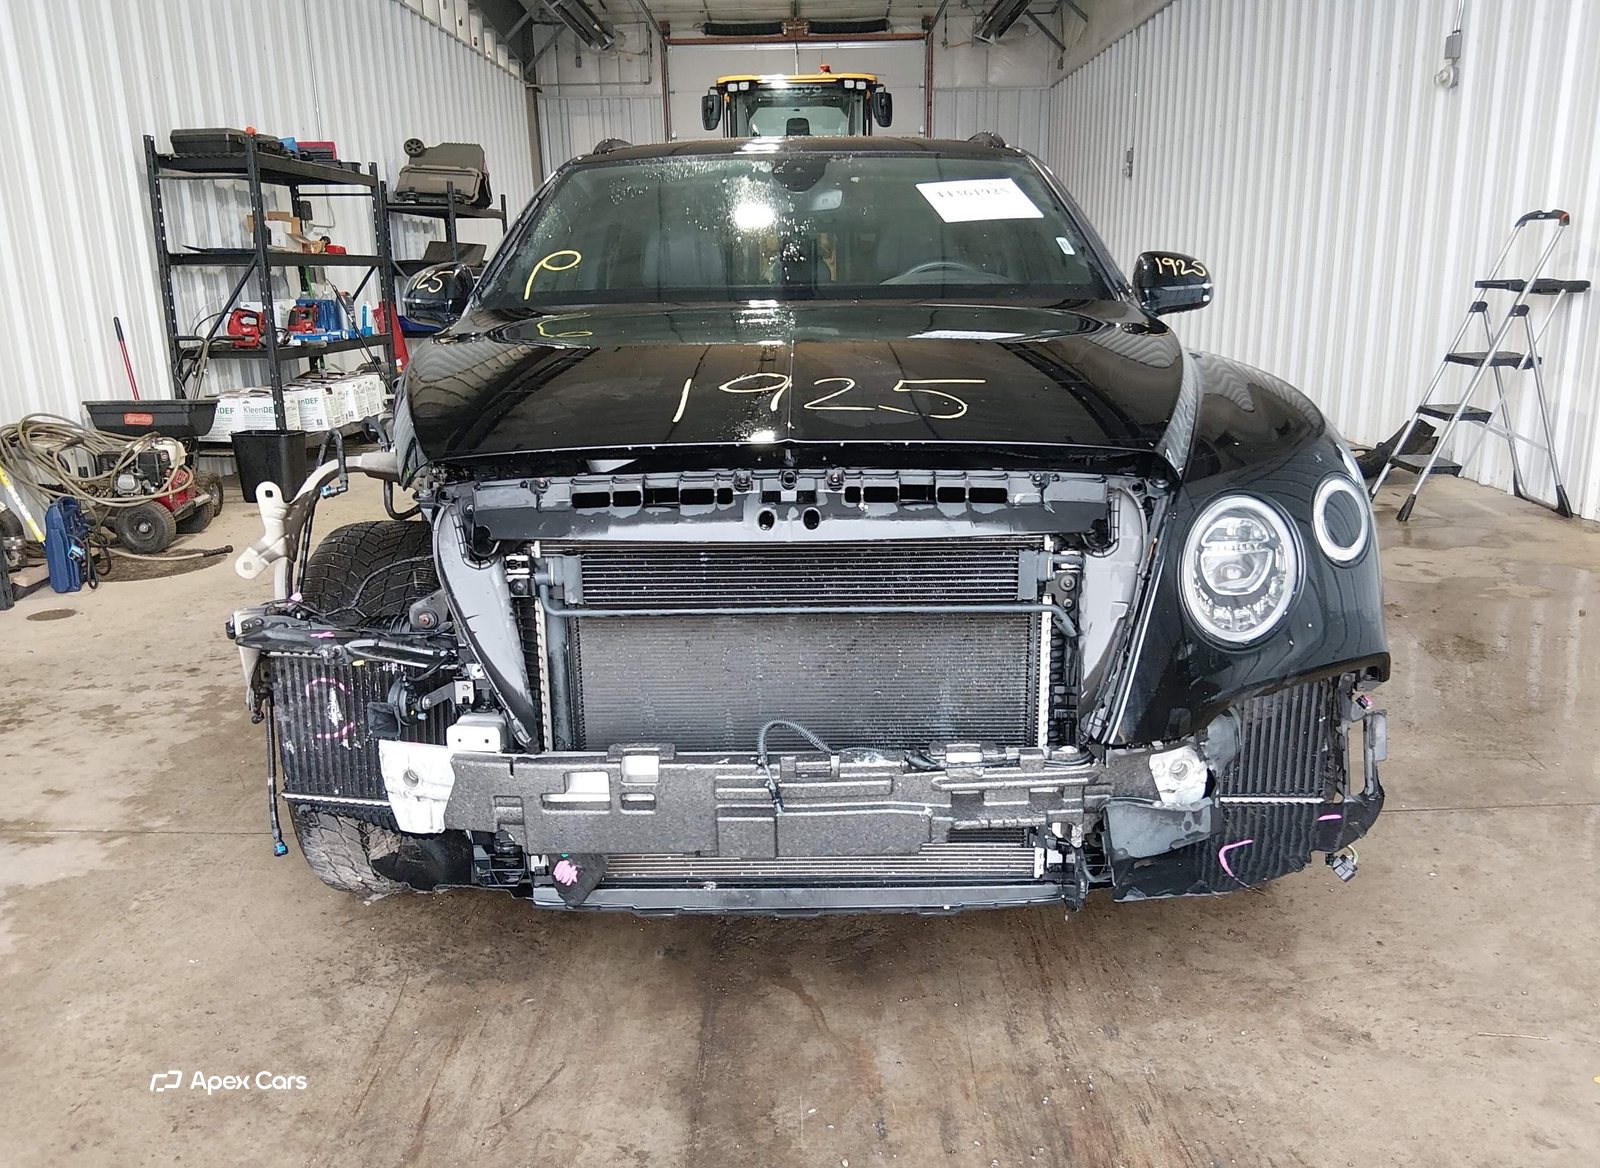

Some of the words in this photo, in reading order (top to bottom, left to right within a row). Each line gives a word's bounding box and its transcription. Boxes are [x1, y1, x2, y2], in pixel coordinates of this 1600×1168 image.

[1154, 257, 1206, 277] 1925
[672, 372, 986, 422] 1925
[243, 406, 274, 414] KleenDE
